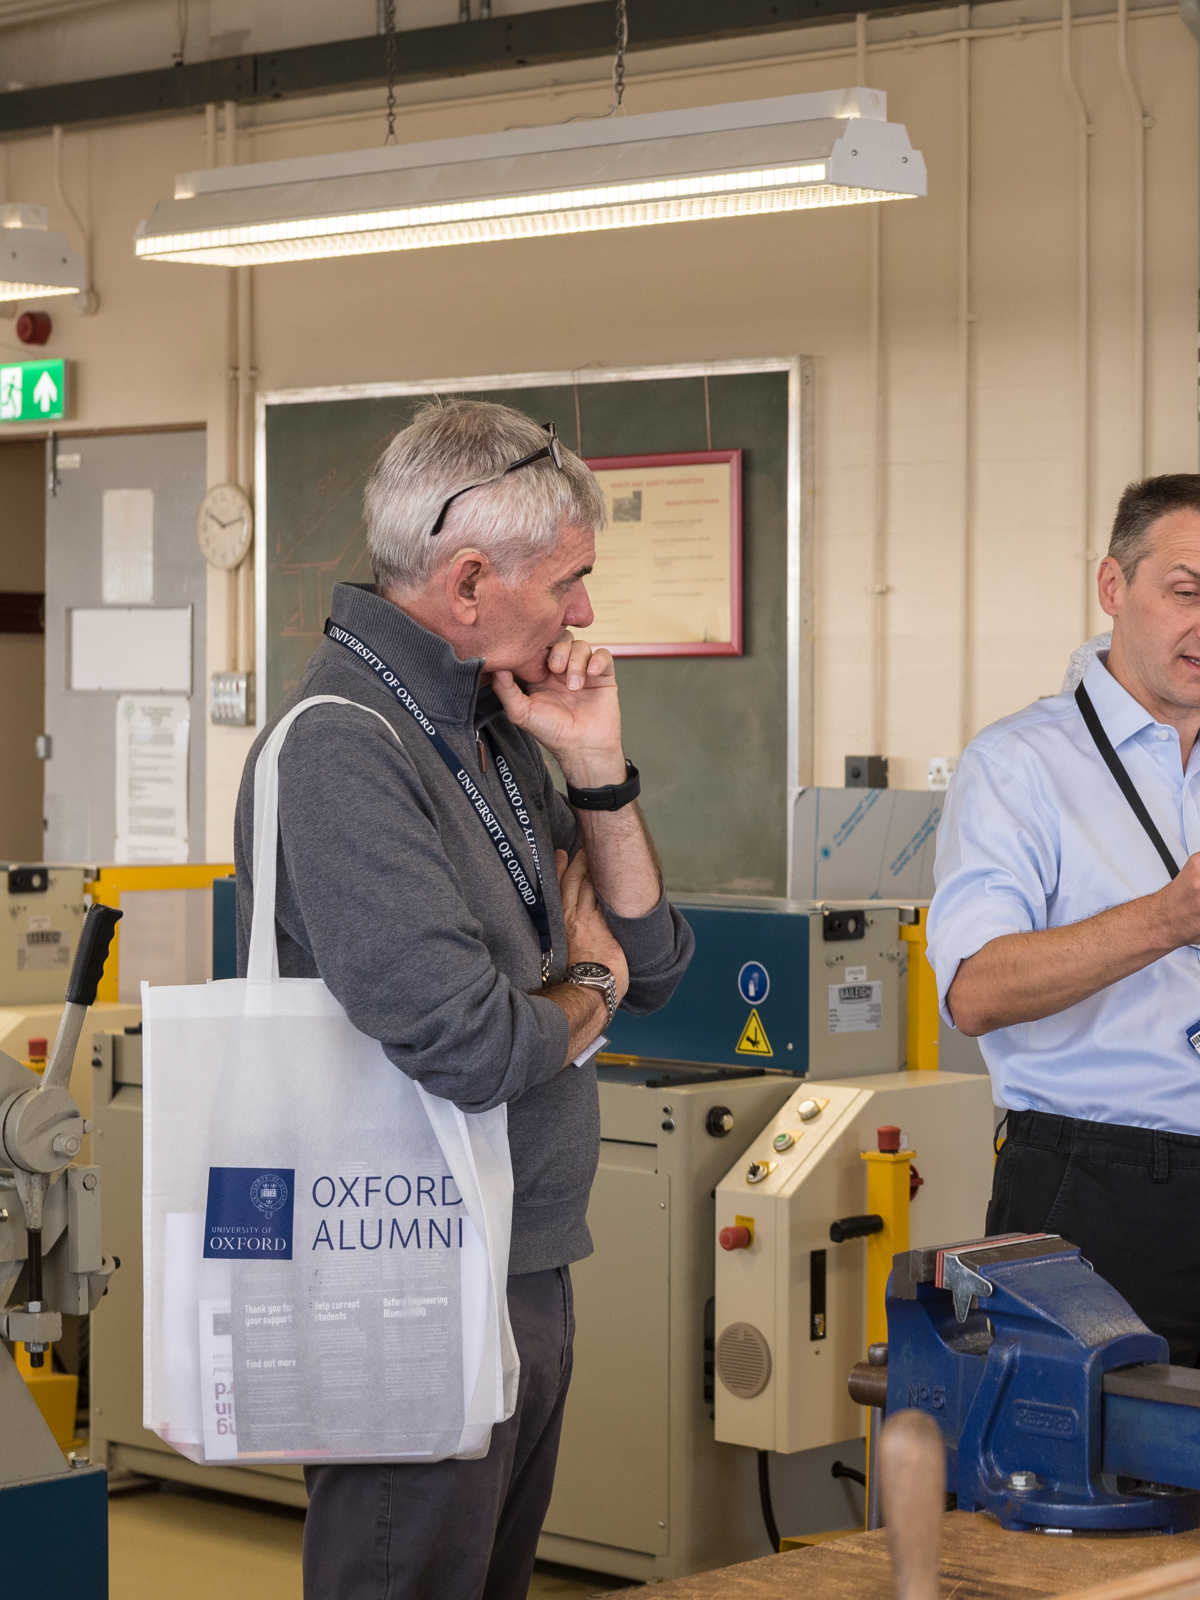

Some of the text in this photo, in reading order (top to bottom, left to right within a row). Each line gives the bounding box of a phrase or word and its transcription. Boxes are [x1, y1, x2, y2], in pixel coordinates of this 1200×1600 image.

[329, 625, 436, 737] UNIVERSITY OF OXFORD
[495, 754, 523, 807] OXFORD
[515, 809, 530, 826] OF
[456, 769, 536, 905] UNIVERSITY OF OXFORD
[312, 1174, 463, 1208] OXFORD
[209, 1236, 287, 1251] OXFORD
[211, 1226, 272, 1235] UNIVERSITY OF
[312, 1217, 463, 1250] ALUMNI
